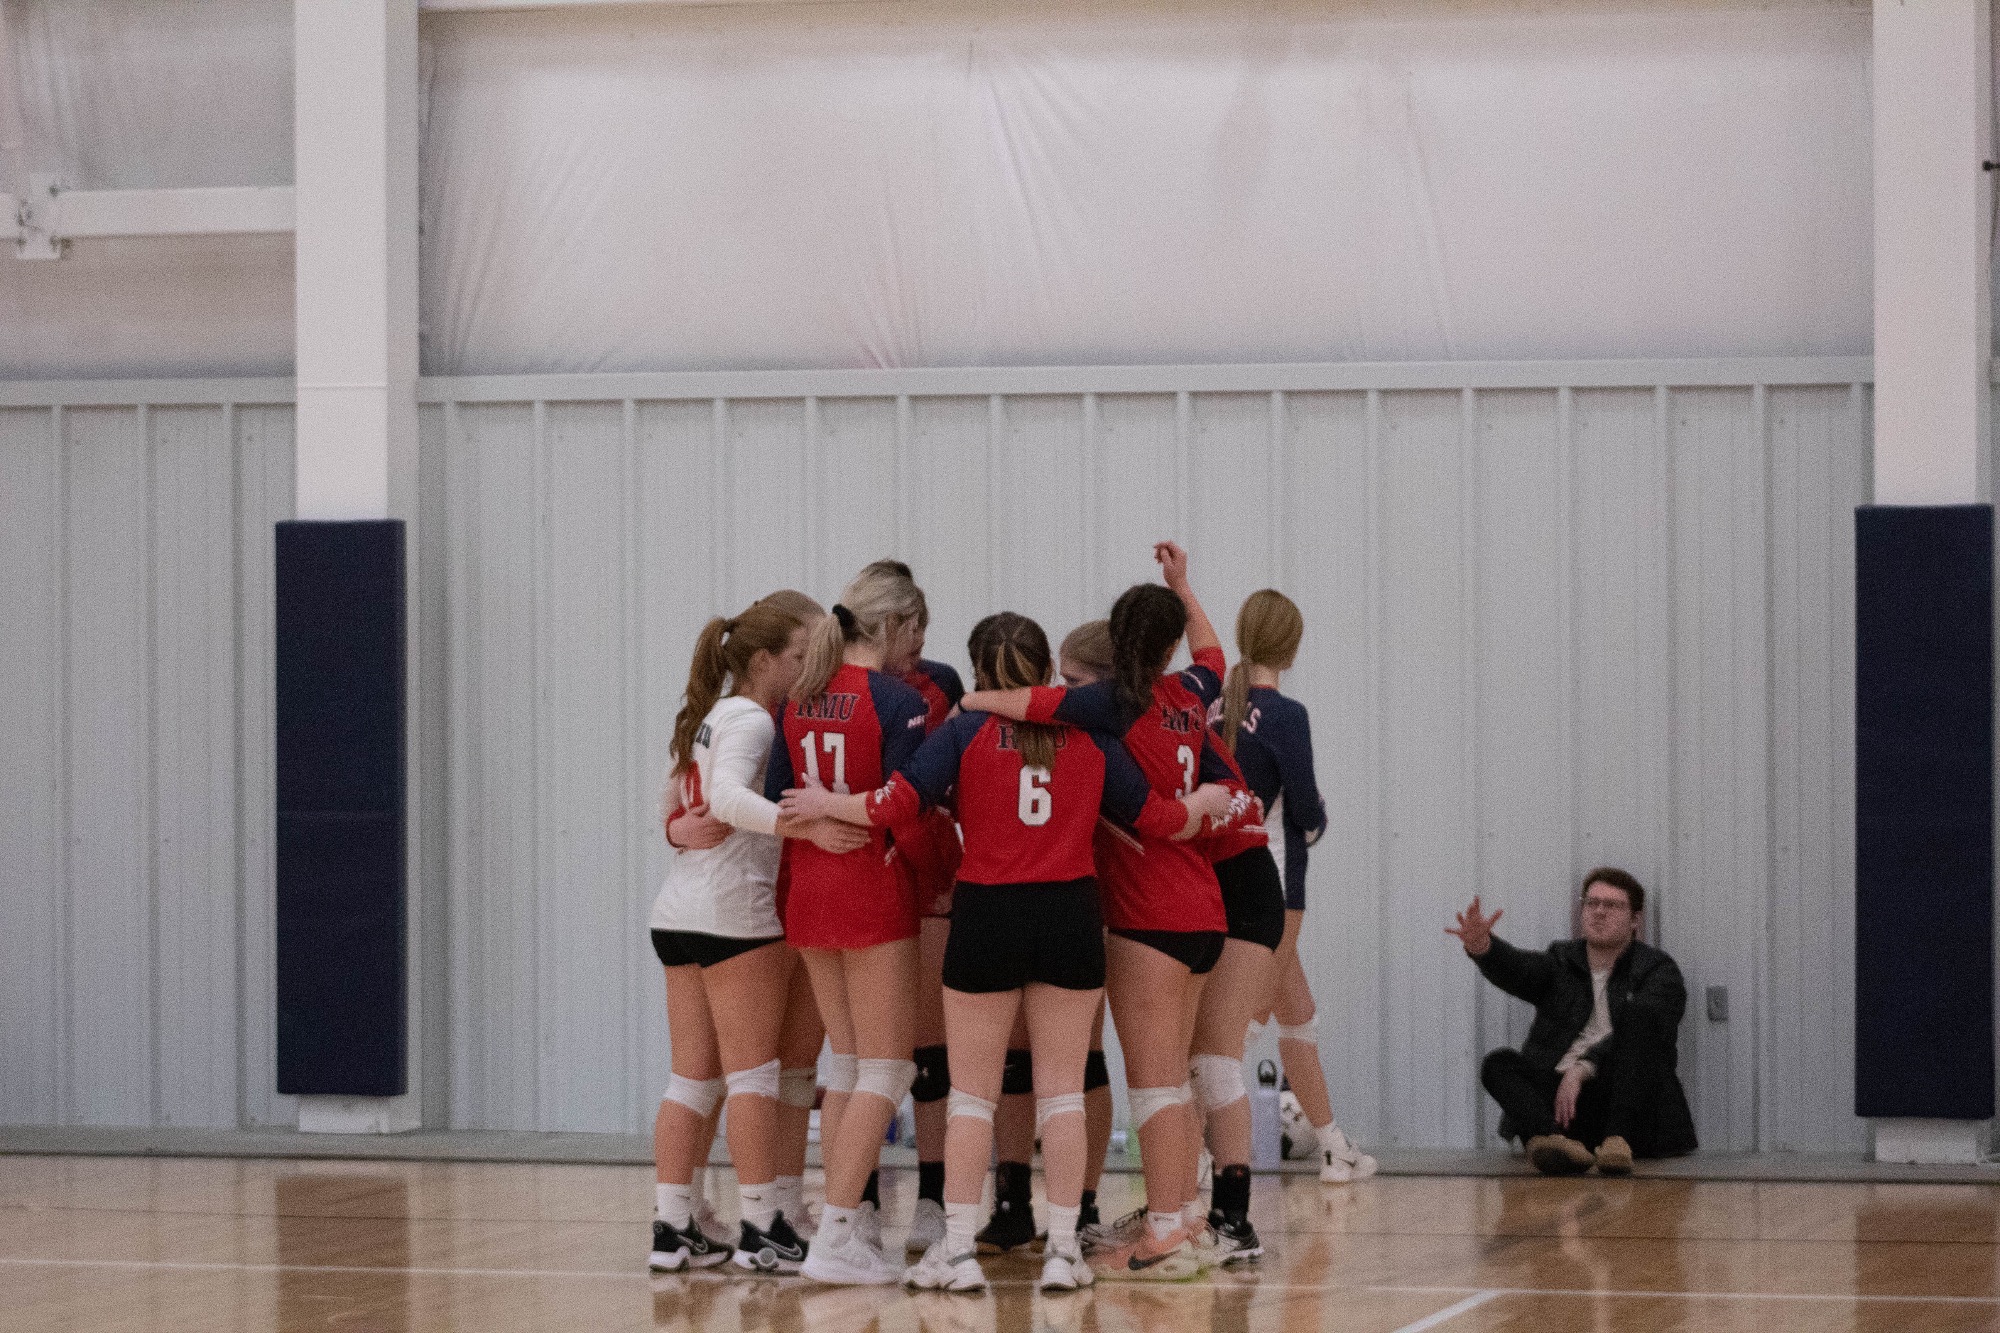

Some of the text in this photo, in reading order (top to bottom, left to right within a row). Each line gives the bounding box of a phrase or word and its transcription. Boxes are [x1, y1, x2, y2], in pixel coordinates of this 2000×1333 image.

[800, 730, 849, 790] 17
[997, 724, 1067, 751] RU
[1018, 763, 1052, 826] 6
[1175, 744, 1195, 800] 3
